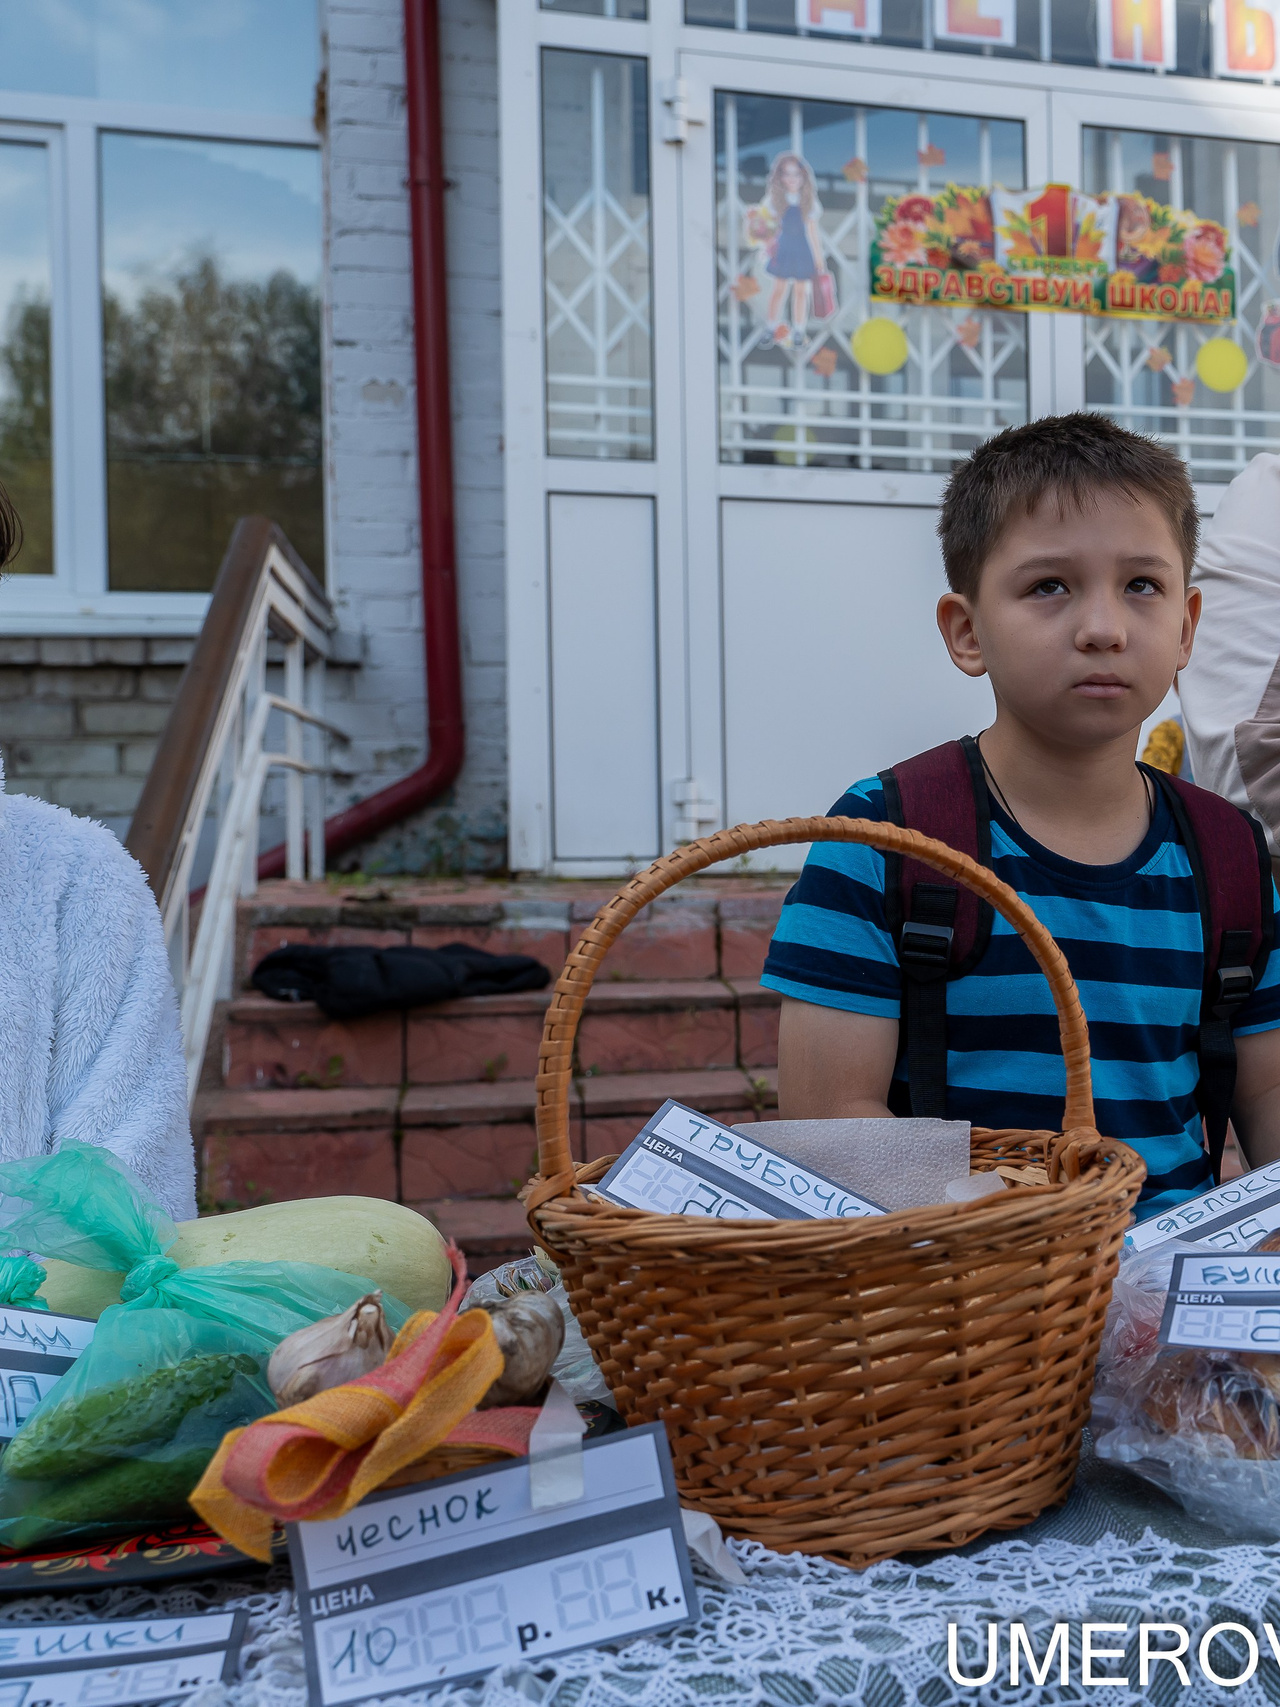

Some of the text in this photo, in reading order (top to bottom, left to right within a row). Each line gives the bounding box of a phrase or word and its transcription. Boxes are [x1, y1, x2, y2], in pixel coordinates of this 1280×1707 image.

[1026, 183, 1072, 259] 1
[1108, 280, 1233, 318] ШКОЛА!
[643, 1136, 684, 1163] ЦЕНА
[689, 1118, 872, 1218] ТРУБОЧК
[1176, 1293, 1226, 1305] ЦЕНА
[310, 1583, 375, 1617] ЦЕНА
[332, 1585, 682, 1674] 10 р. к.
